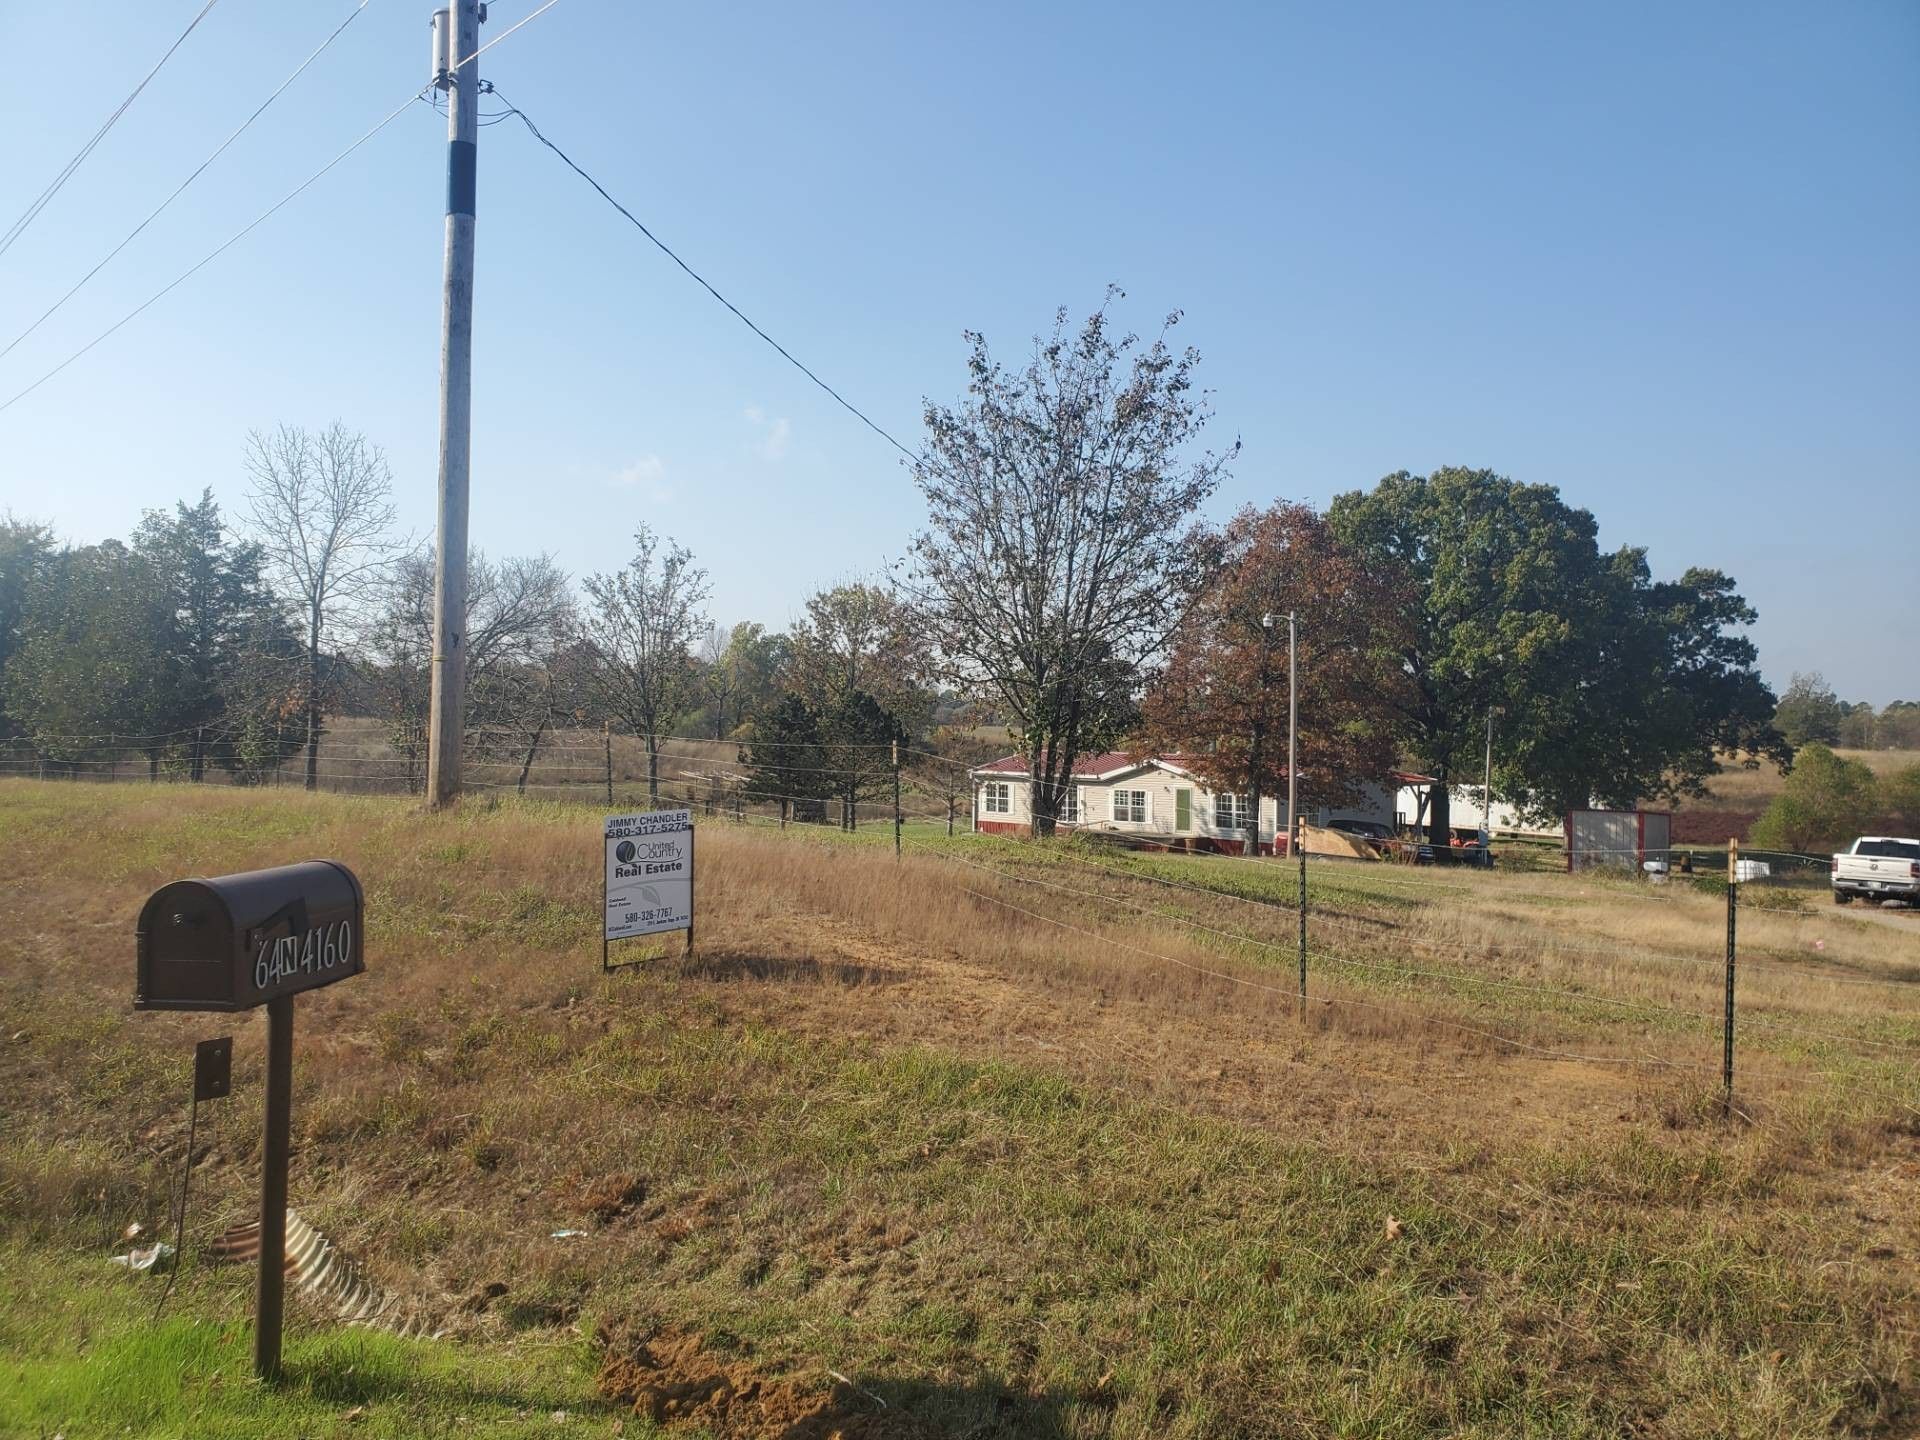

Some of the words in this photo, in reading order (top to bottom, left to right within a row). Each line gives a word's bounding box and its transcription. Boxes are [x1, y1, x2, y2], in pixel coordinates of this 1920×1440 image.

[608, 817, 637, 828] JIMMY
[640, 812, 688, 825] CHANDLER
[607, 822, 688, 837] 580-317-5275
[637, 843, 683, 859] Country
[648, 840, 675, 850] United
[615, 865, 642, 879] Real
[646, 862, 682, 875] Estate
